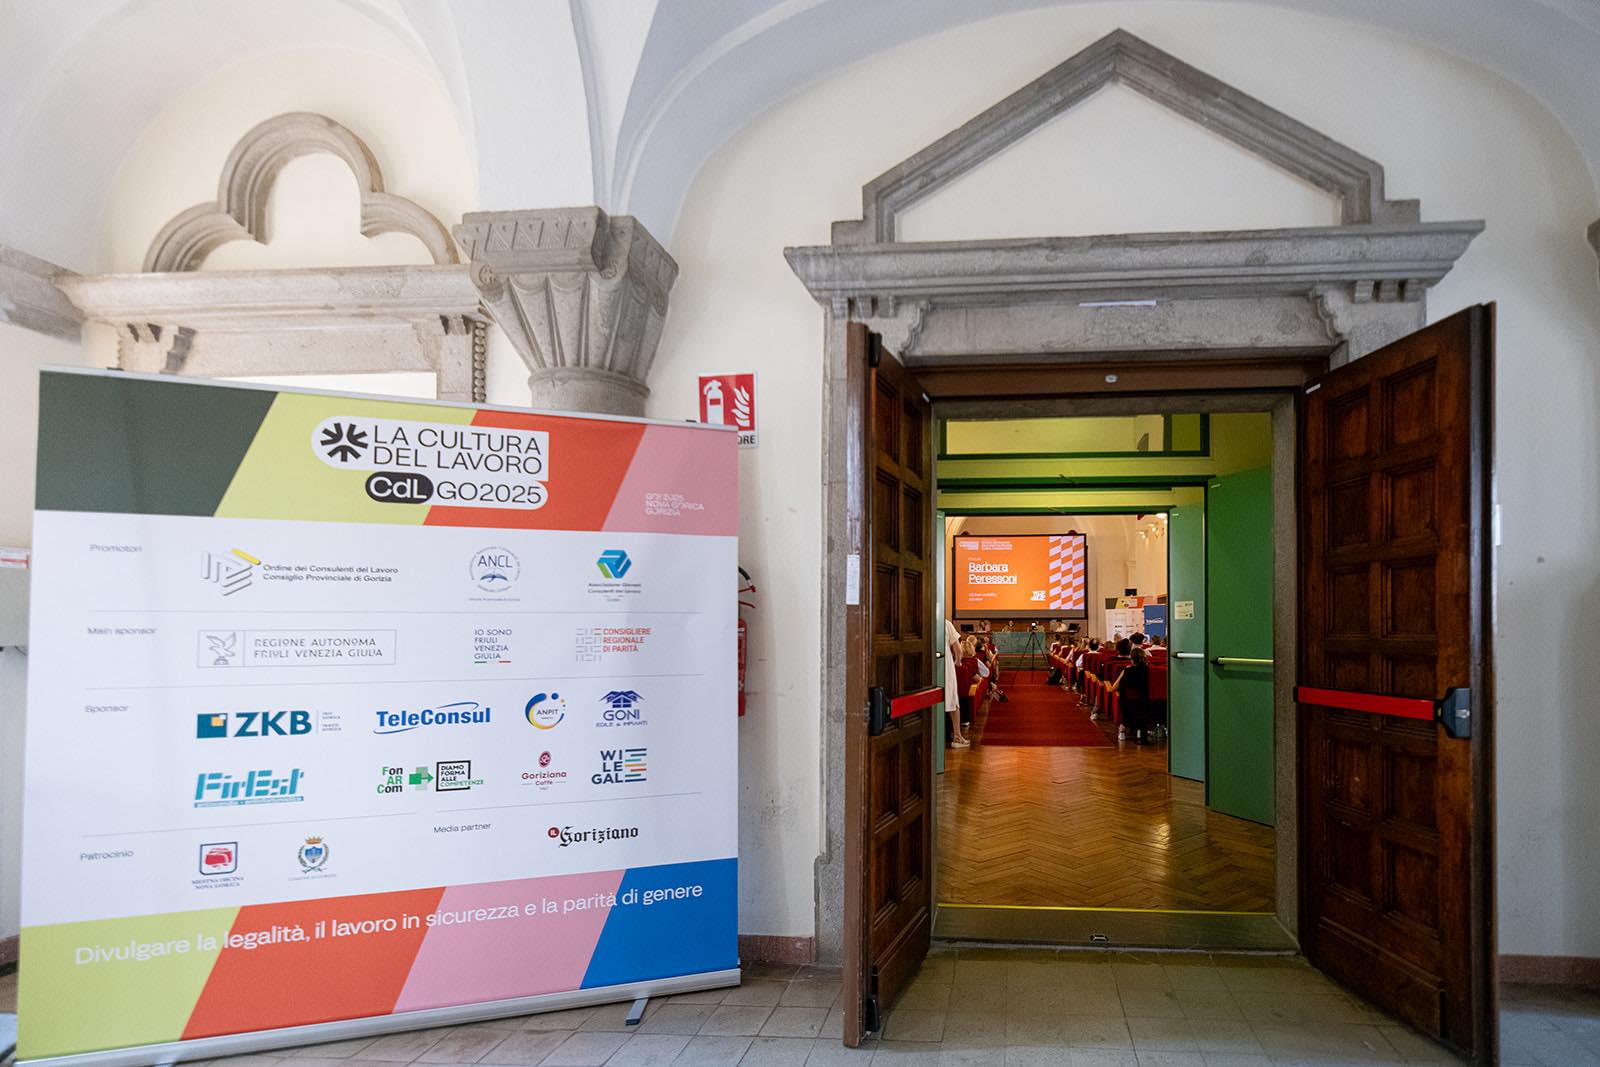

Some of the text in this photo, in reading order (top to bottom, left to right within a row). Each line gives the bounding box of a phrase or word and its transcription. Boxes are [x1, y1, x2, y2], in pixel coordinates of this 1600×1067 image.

[374, 424, 542, 455] LA CULTURA
[373, 446, 542, 475] DEL LAVORO
[369, 476, 542, 504] CdL GO2025
[477, 554, 513, 568] ANCL
[263, 564, 292, 572] Ordine
[309, 565, 354, 573] Consulenti
[370, 566, 399, 574] Lavoro
[968, 562, 1009, 573] Barbara
[263, 573, 304, 582] Consiglio
[354, 574, 362, 582] di
[363, 575, 392, 583] Gorizia
[968, 574, 1018, 585] Peressoni
[474, 628, 513, 636] IO SONO
[603, 628, 652, 636] CONSIGLIERE
[254, 638, 376, 647] REGIONE AUTONOMA
[474, 636, 498, 644] FRIULI
[603, 636, 645, 644] REGIONALE
[254, 648, 383, 658] FRIULI VENEZIA GIULIA
[474, 644, 510, 652] VENEZIA
[474, 652, 502, 660] GIULIA
[85, 705, 129, 714] Sponsor
[536, 708, 558, 716] ANPIT
[376, 707, 491, 727] TeleConsul
[602, 709, 640, 722] GONI
[233, 710, 313, 738] ZKB
[382, 766, 404, 776] Fon
[521, 771, 567, 780] Goriziana
[386, 776, 403, 785] AR
[440, 780, 484, 788] COMPETENZE
[376, 784, 403, 794] Com
[433, 823, 492, 834] Media partner
[559, 825, 640, 848] Goriziano
[80, 850, 134, 861] Patrocinio
[75, 882, 704, 966] Divulgare la legalità, il lavoro in sicurezza e la parità di genere
